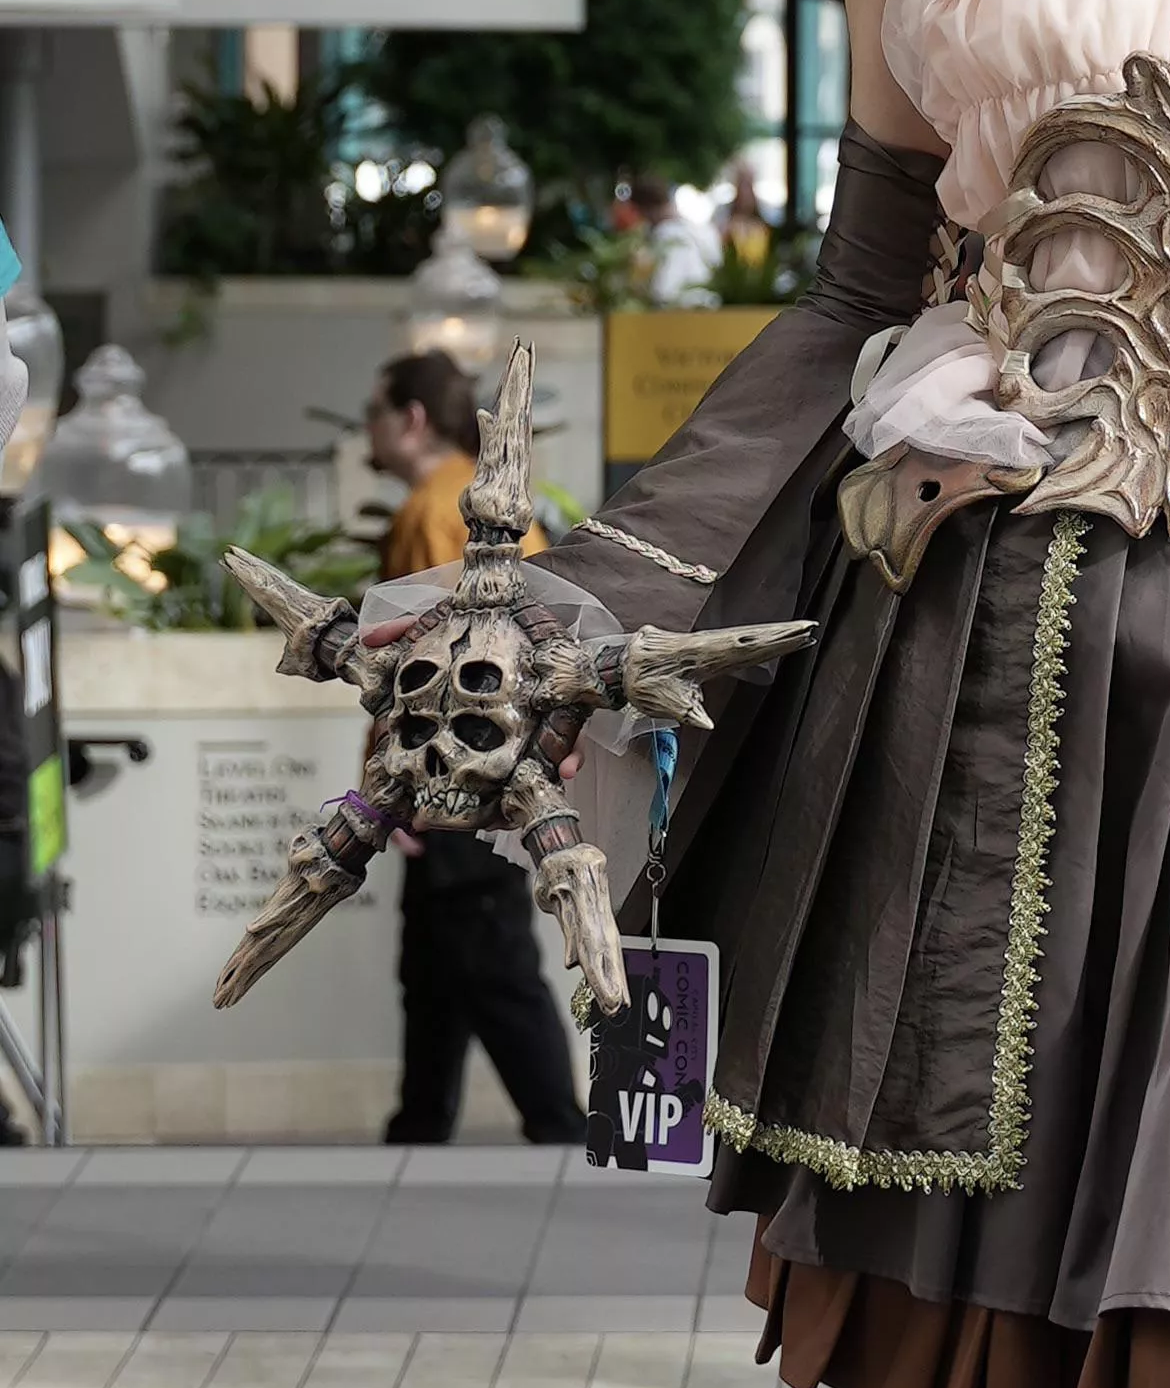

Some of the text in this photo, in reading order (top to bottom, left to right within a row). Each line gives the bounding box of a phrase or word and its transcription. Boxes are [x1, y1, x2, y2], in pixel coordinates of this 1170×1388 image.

[674, 961, 690, 1087] COMIC CON
[618, 1089, 684, 1146] VIP
